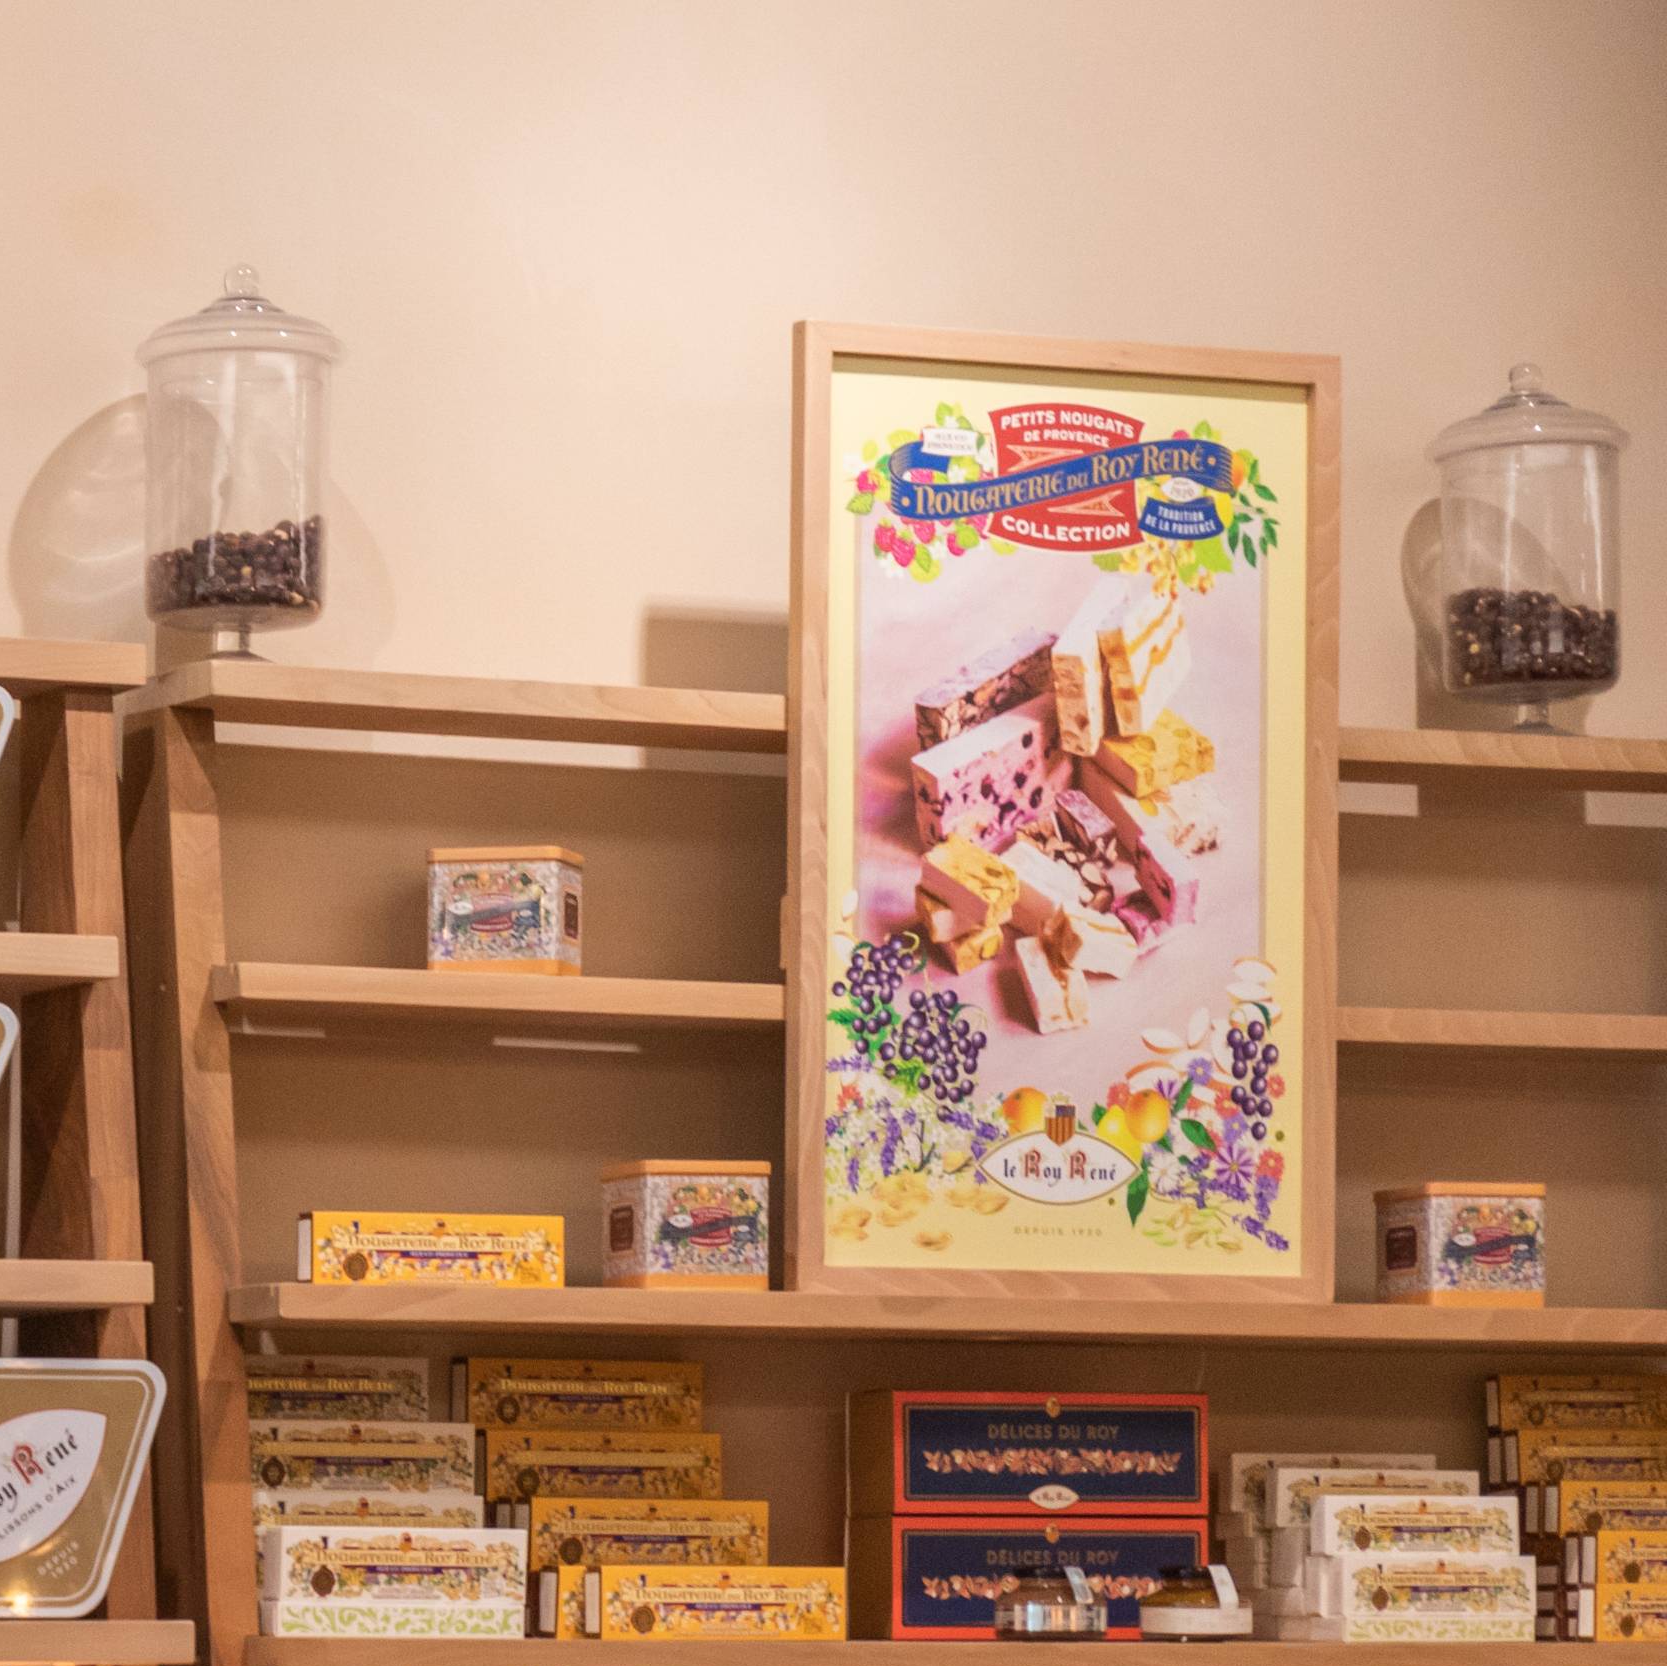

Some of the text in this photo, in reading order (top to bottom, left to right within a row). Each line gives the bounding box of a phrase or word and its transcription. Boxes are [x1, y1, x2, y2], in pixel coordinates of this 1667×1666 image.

[1000, 409, 1135, 439] PETITS NOUGATS
[1023, 429, 1110, 448] DE PROVENCE
[915, 470, 1063, 516] NOUGATERIE
[1066, 470, 1089, 489] DU
[1001, 515, 1131, 542] COLLECTION
[1003, 1150, 1117, 1185] le Roy René
[987, 1422, 1120, 1440] DÉLICES DU ROY
[11, 1428, 78, 1485] René
[986, 1548, 1052, 1565] DÉLICES
[1086, 1550, 1119, 1564] ROY
